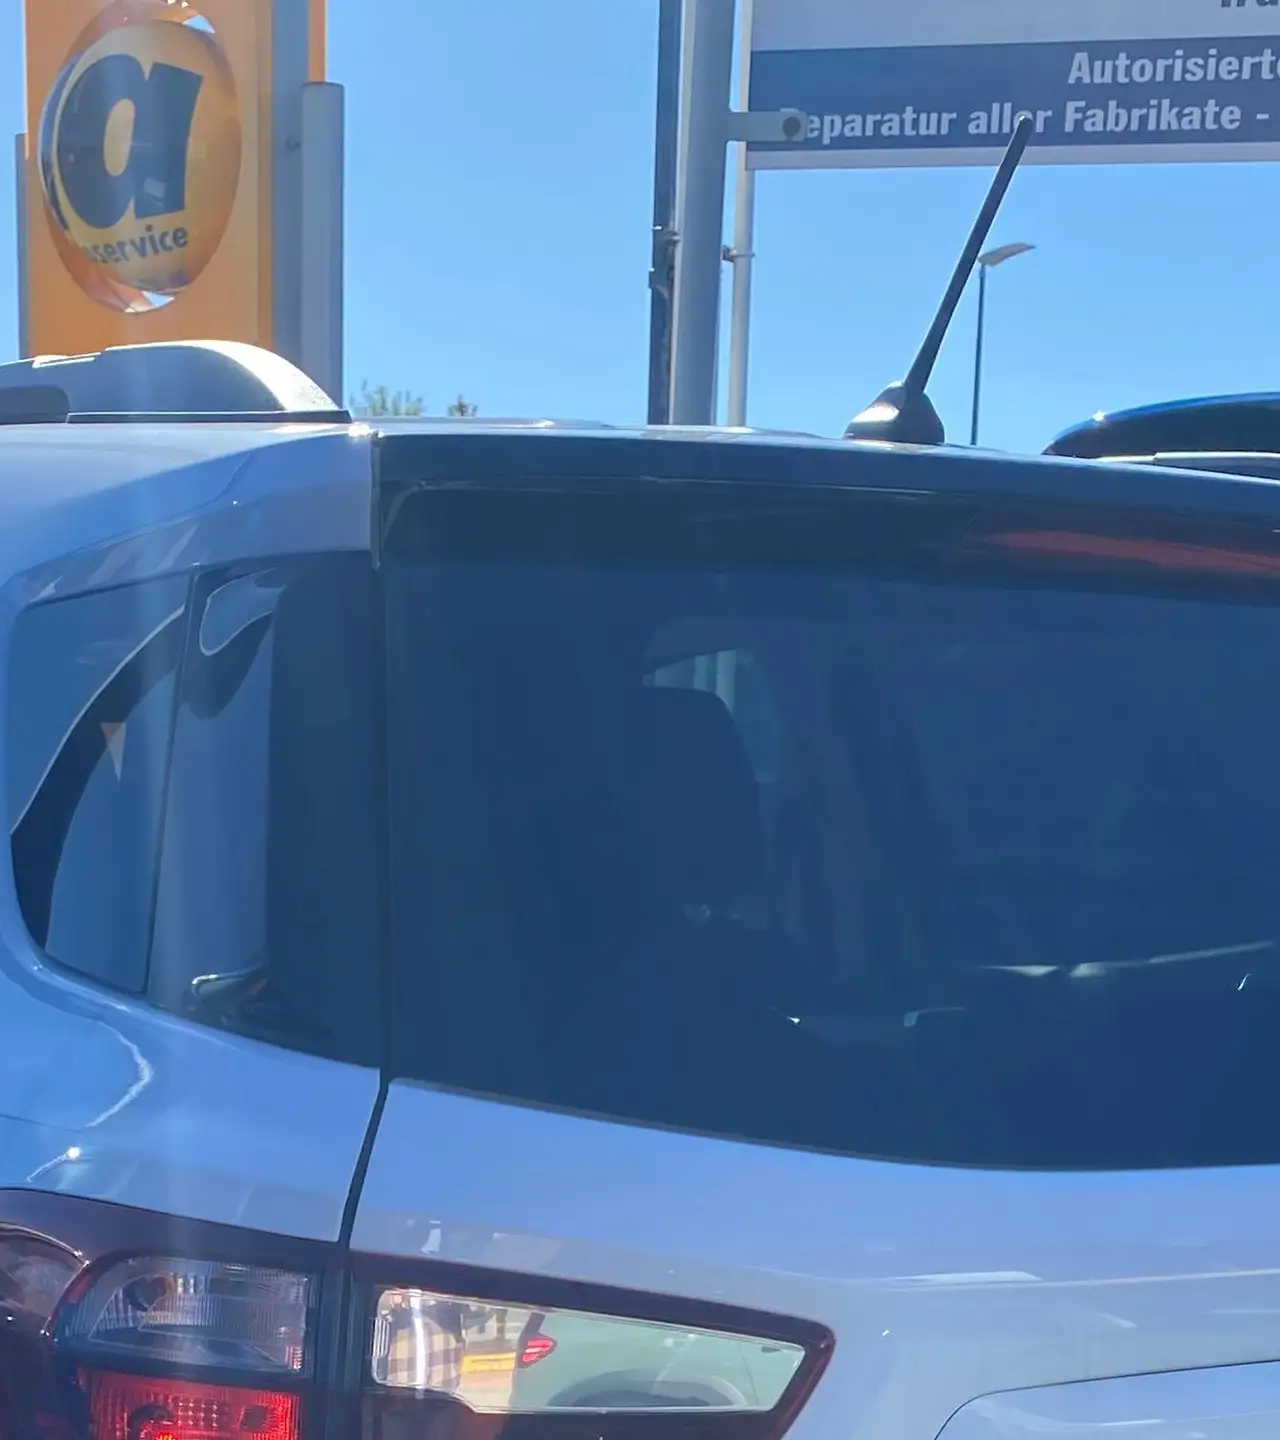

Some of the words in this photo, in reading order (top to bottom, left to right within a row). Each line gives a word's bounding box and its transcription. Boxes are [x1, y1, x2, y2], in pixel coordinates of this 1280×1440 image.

[780, 106, 957, 145] eparatur
[1064, 95, 1241, 133] Fabrikate
[90, 225, 188, 264] service
